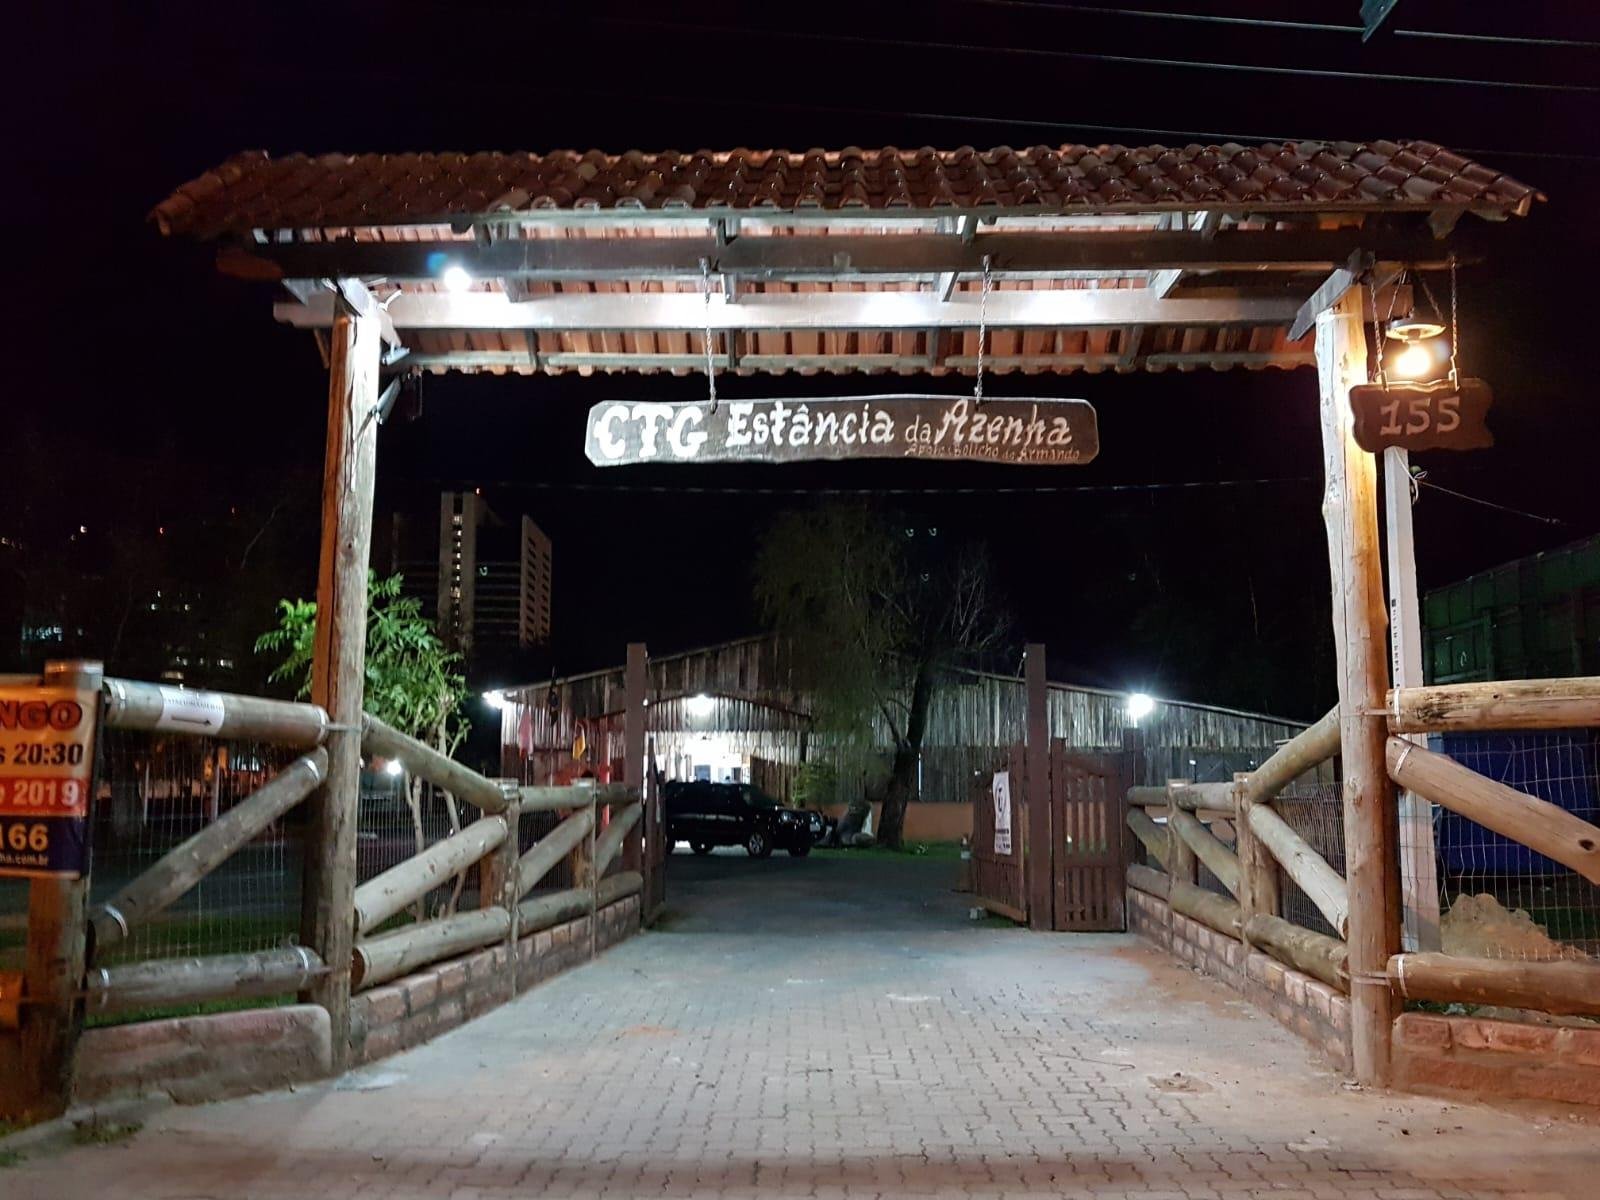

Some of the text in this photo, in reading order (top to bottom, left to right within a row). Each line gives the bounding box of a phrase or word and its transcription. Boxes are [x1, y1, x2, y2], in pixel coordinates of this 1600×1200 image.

[594, 399, 1073, 458] CTG Estância da Azenha
[1380, 397, 1461, 435] 155
[0, 700, 83, 731] NGO
[14, 743, 84, 766] 20:30
[12, 779, 80, 807] 2019
